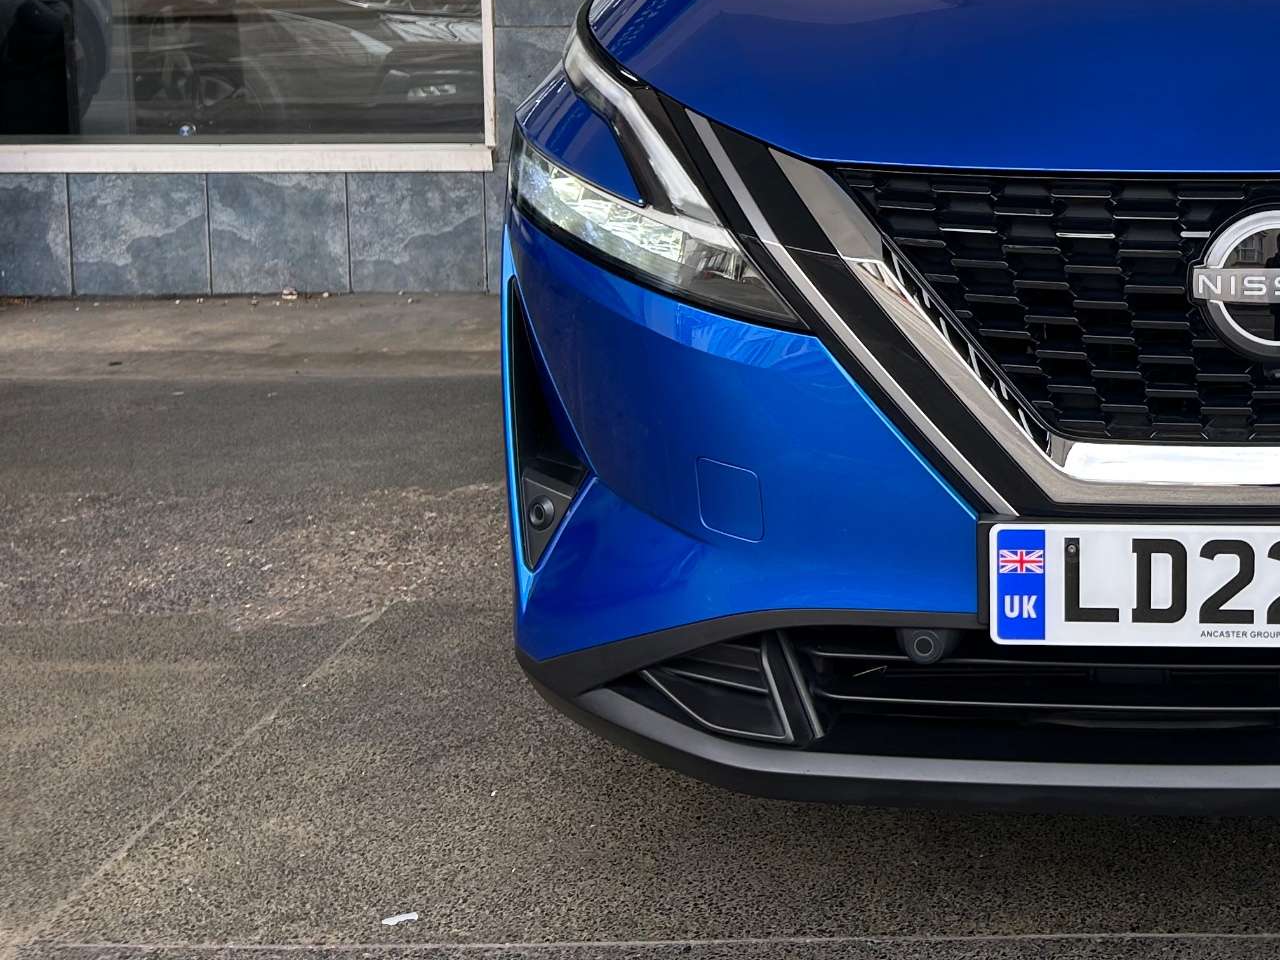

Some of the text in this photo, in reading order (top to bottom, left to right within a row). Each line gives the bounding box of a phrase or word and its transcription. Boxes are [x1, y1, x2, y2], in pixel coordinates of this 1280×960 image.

[1004, 595, 1037, 619] UK
[1200, 630, 1248, 639] ANCASTER
[1250, 631, 1280, 639] GROUP
